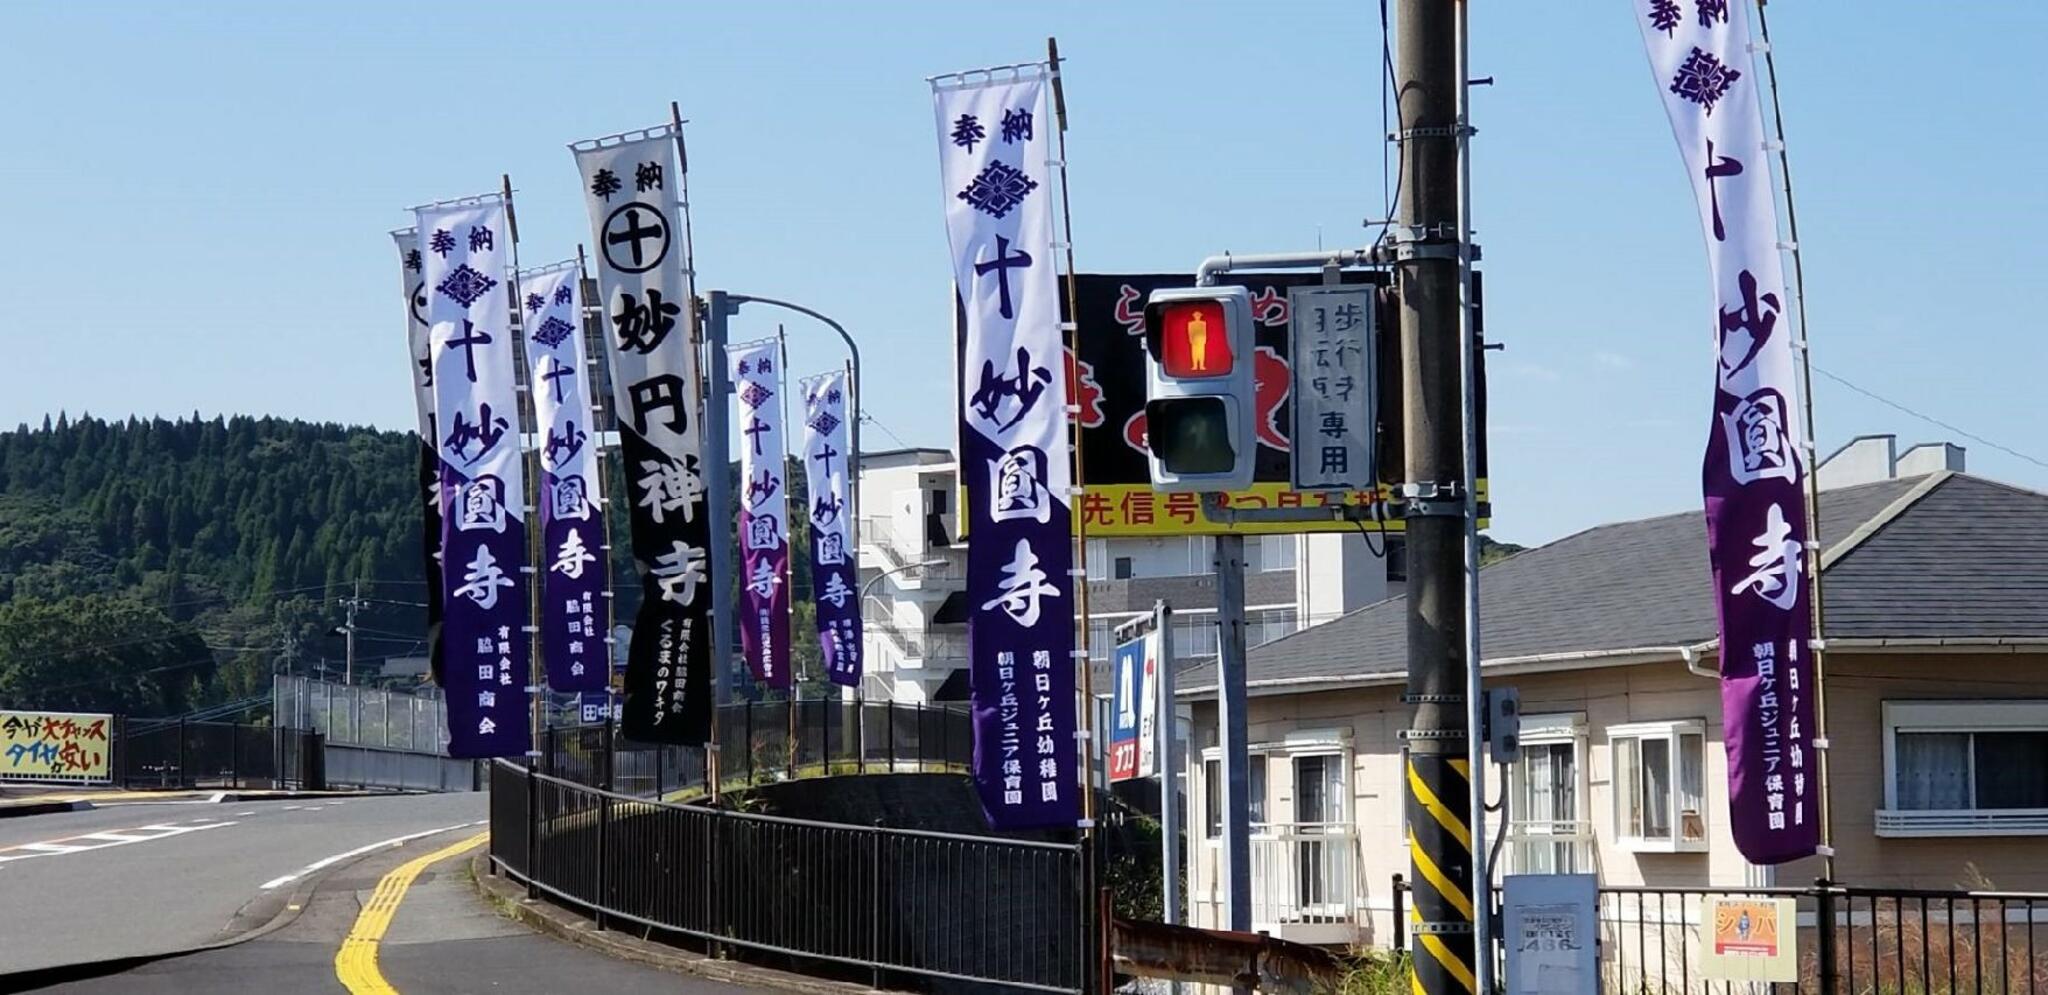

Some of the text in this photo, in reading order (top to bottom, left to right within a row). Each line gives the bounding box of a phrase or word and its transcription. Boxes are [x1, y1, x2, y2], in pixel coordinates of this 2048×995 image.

[950, 107, 1034, 155] 奉納
[591, 160, 664, 202] 奉納
[429, 225, 494, 259] 奉納
[526, 284, 573, 313] 奉納
[1318, 410, 1349, 475] 専用
[565, 599, 585, 677] 脇田商会
[582, 590, 595, 638] 有限会社
[497, 624, 513, 687] 有限会社
[653, 618, 674, 726] くるまのワキタ
[476, 635, 497, 735] 脇田商会
[2, 715, 107, 741] 今が大チャンス
